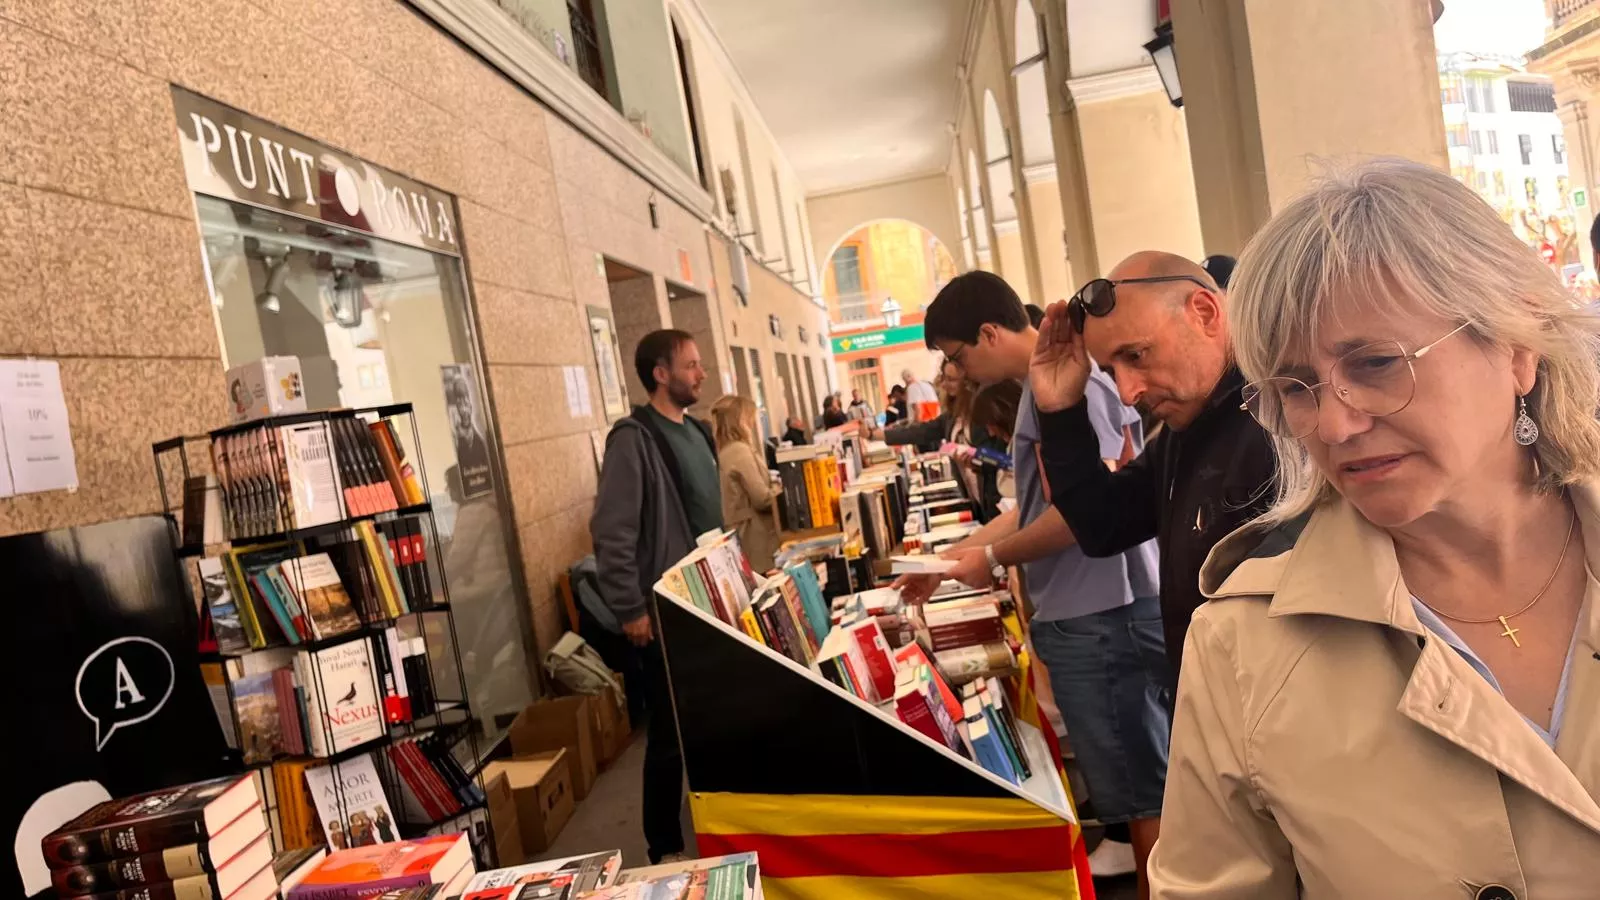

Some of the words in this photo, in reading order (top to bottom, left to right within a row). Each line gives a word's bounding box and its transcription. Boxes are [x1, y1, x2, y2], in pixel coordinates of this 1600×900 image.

[189, 112, 317, 206] PUNT
[370, 178, 455, 245] ROMA
[115, 656, 146, 709] A
[322, 703, 380, 731] Nexus
